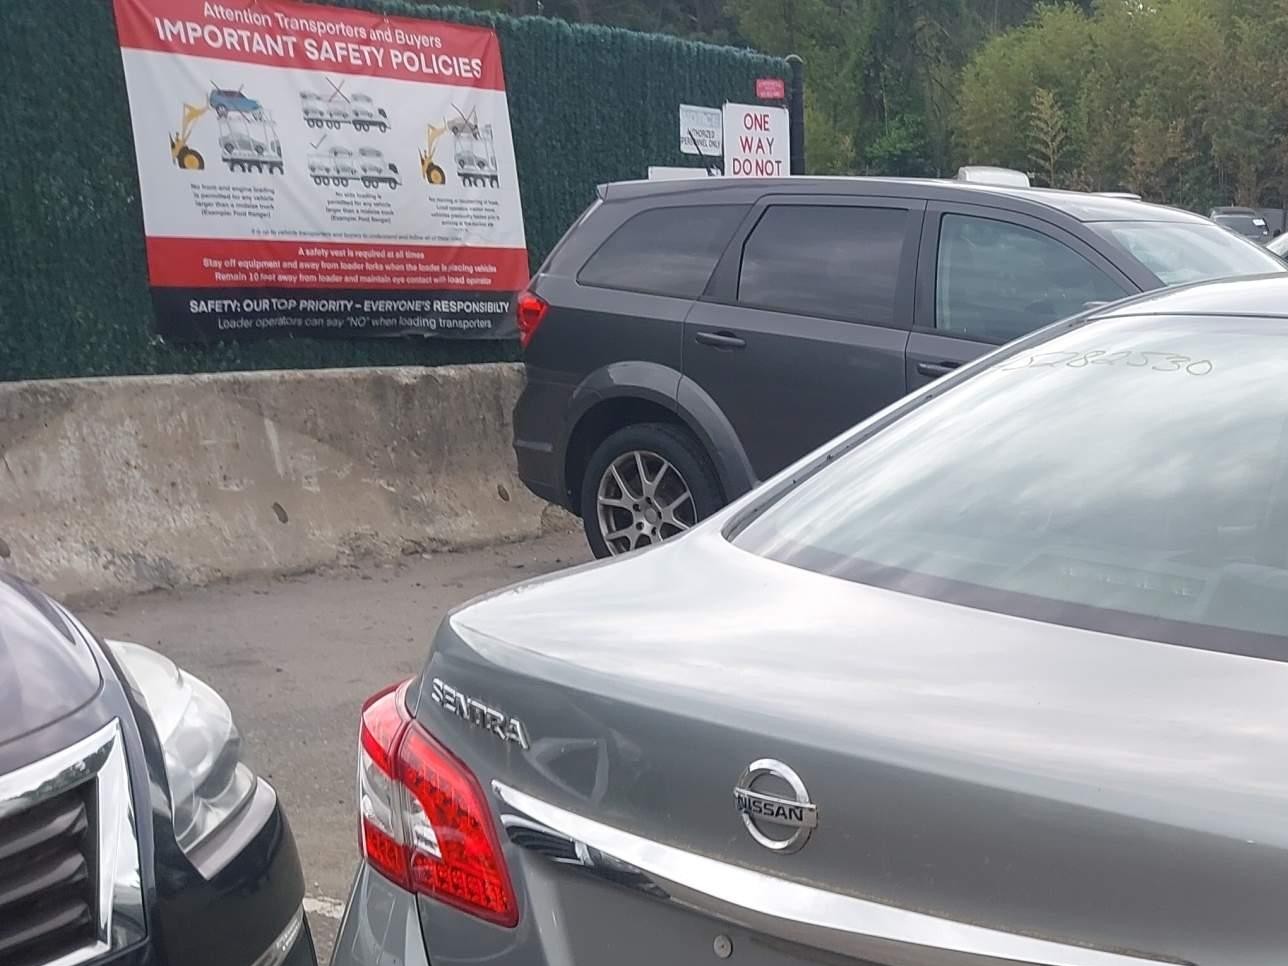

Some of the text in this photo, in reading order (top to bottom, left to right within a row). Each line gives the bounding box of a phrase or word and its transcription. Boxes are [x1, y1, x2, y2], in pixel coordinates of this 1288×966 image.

[204, 1, 442, 48] Attention Transporters and Buyers
[155, 17, 482, 79] IMPORTANT SAFETY POLICIES
[744, 113, 769, 131] ONE
[740, 136, 774, 155] WAY
[733, 158, 782, 176] DO NOT
[189, 300, 241, 313] SAFETY:
[243, 299, 269, 312] OUR
[271, 298, 297, 310] TOP
[300, 300, 353, 312] PRIORITY
[218, 317, 252, 330] Loader
[255, 316, 302, 328] operators
[305, 317, 324, 327] can
[326, 318, 344, 328] say
[371, 316, 397, 327] when
[399, 316, 436, 329] loading
[439, 318, 492, 330] transporters
[432, 678, 529, 750] SENTRA
[737, 795, 803, 822] NISSAN
